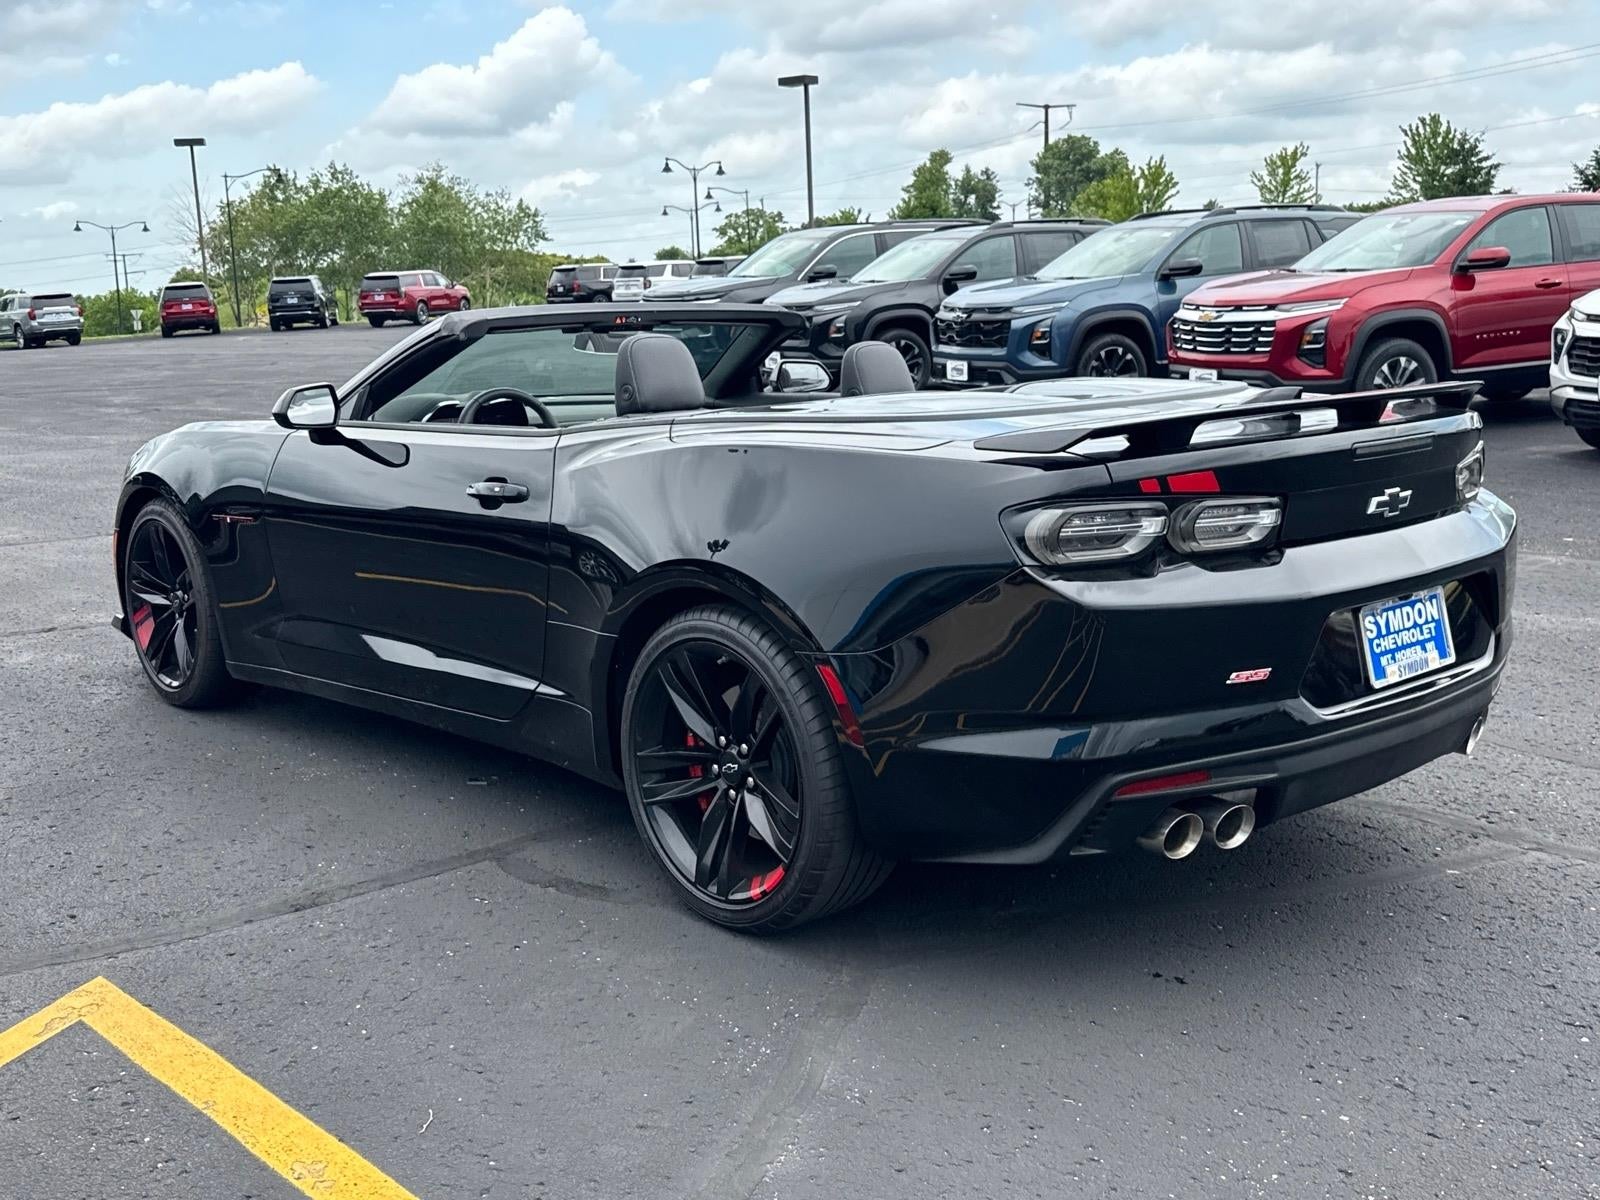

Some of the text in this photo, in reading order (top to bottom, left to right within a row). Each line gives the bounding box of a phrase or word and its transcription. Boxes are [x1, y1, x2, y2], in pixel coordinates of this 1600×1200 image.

[1364, 599, 1439, 639] SYMDON
[1373, 622, 1437, 654] CHEVROLET
[1397, 655, 1430, 678] SYMDON
